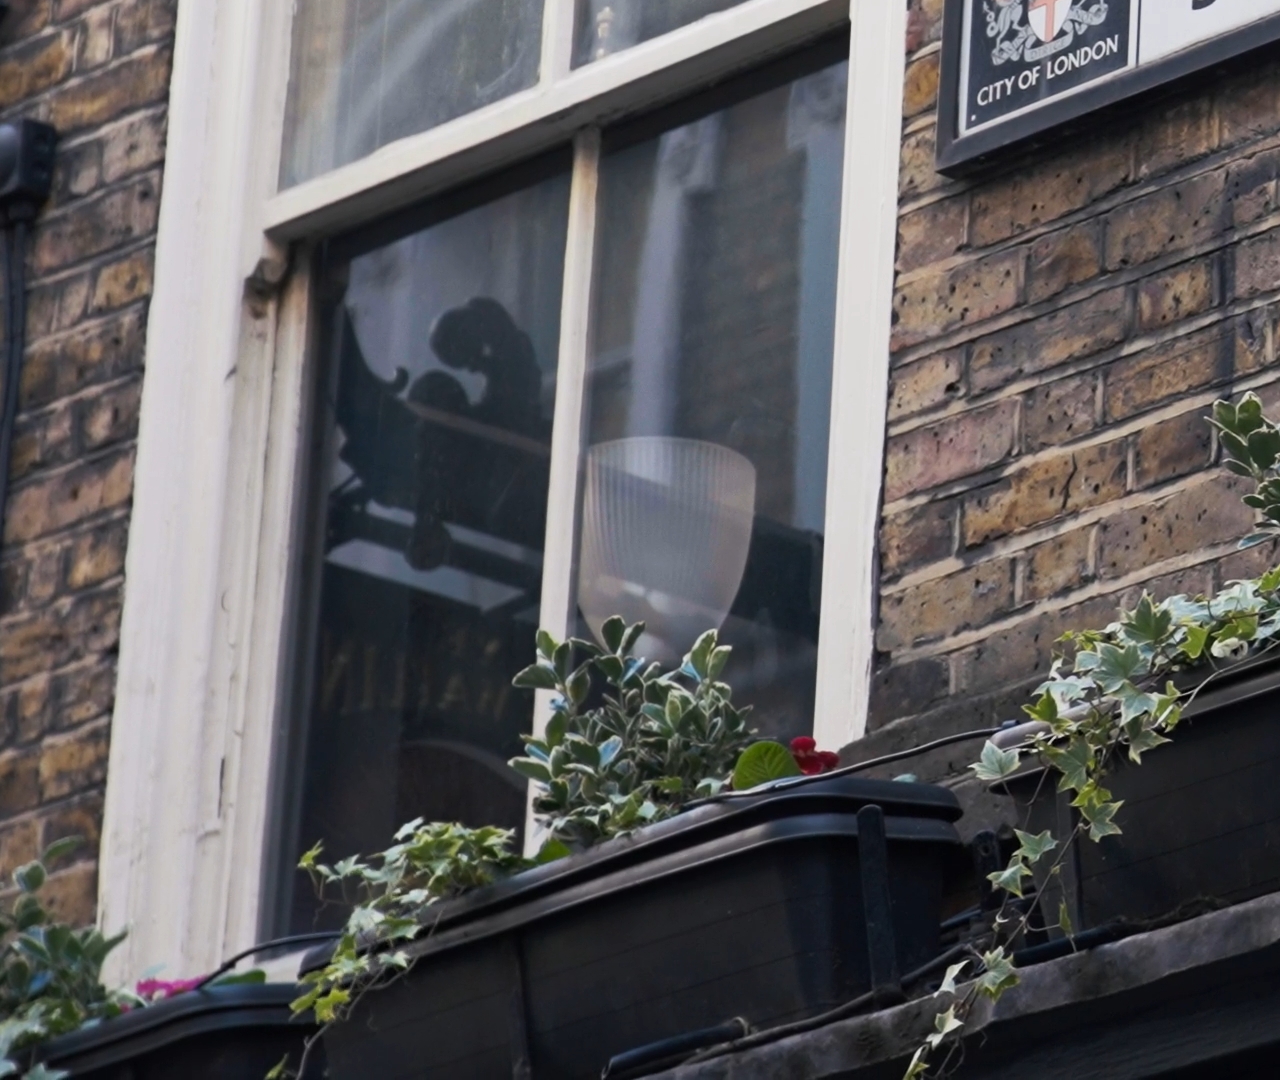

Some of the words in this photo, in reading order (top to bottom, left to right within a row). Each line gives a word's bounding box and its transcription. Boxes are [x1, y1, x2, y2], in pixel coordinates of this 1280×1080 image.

[976, 75, 1016, 106] CITY
[1017, 65, 1041, 90] OF
[1046, 34, 1119, 80] LONDON
